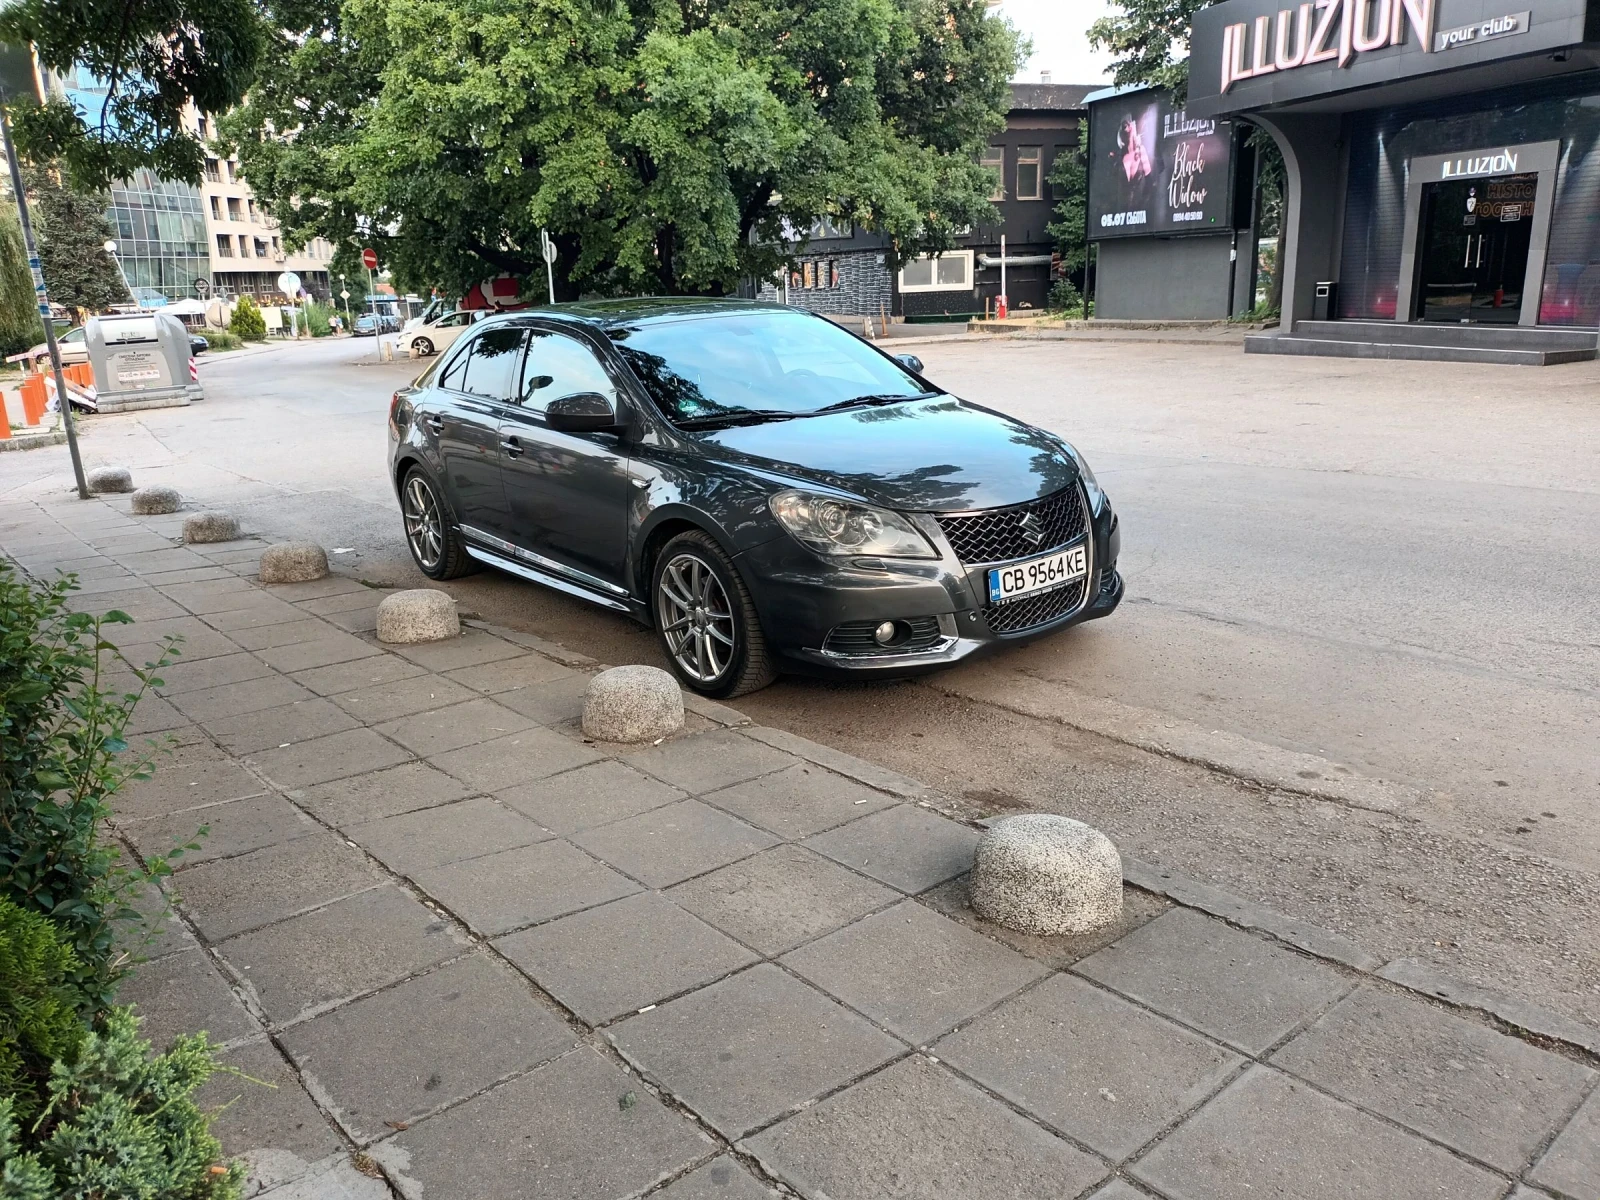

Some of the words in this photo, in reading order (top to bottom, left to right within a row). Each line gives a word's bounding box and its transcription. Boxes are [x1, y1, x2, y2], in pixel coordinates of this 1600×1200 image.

[1220, 0, 1435, 94] ILLUZION
[1441, 26, 1473, 48] your
[1481, 15, 1514, 36] club
[1174, 142, 1205, 180] Black
[1442, 149, 1517, 179] ILLUZION
[1167, 175, 1207, 208] Widow
[1487, 183, 1535, 199] HISTO
[1101, 213, 1125, 227] 05.07
[1126, 210, 1146, 224] СЪБОТА
[1002, 569, 1026, 594] CB
[1028, 556, 1064, 587] 9564
[1067, 551, 1084, 575] KE
[991, 588, 1000, 597] BG
